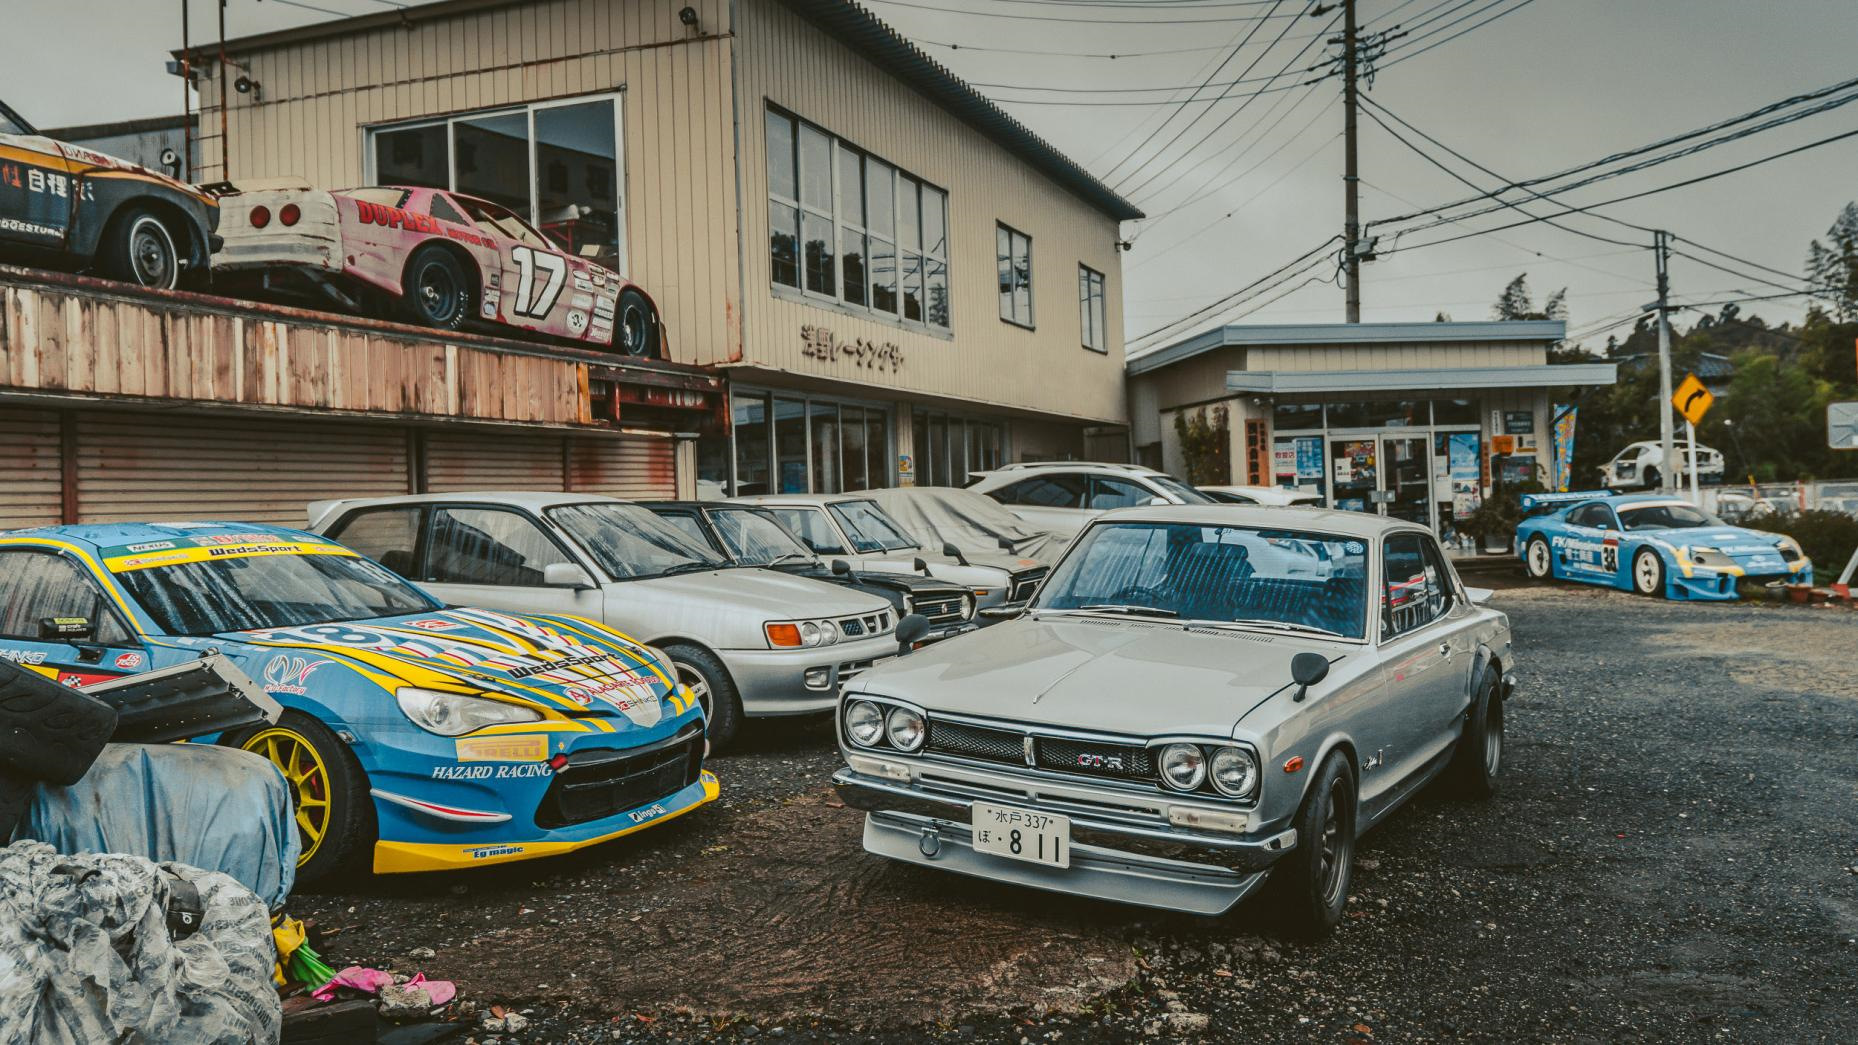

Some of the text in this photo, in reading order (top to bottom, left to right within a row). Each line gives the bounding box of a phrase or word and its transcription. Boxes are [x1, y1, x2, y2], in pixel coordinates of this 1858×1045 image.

[511, 245, 568, 320] 17
[208, 545, 303, 556] WedsSport
[506, 652, 622, 679] WedsSport
[431, 762, 553, 779] HAZARD RACING
[995, 810, 1048, 830] 水戸 337
[489, 846, 524, 856] magic
